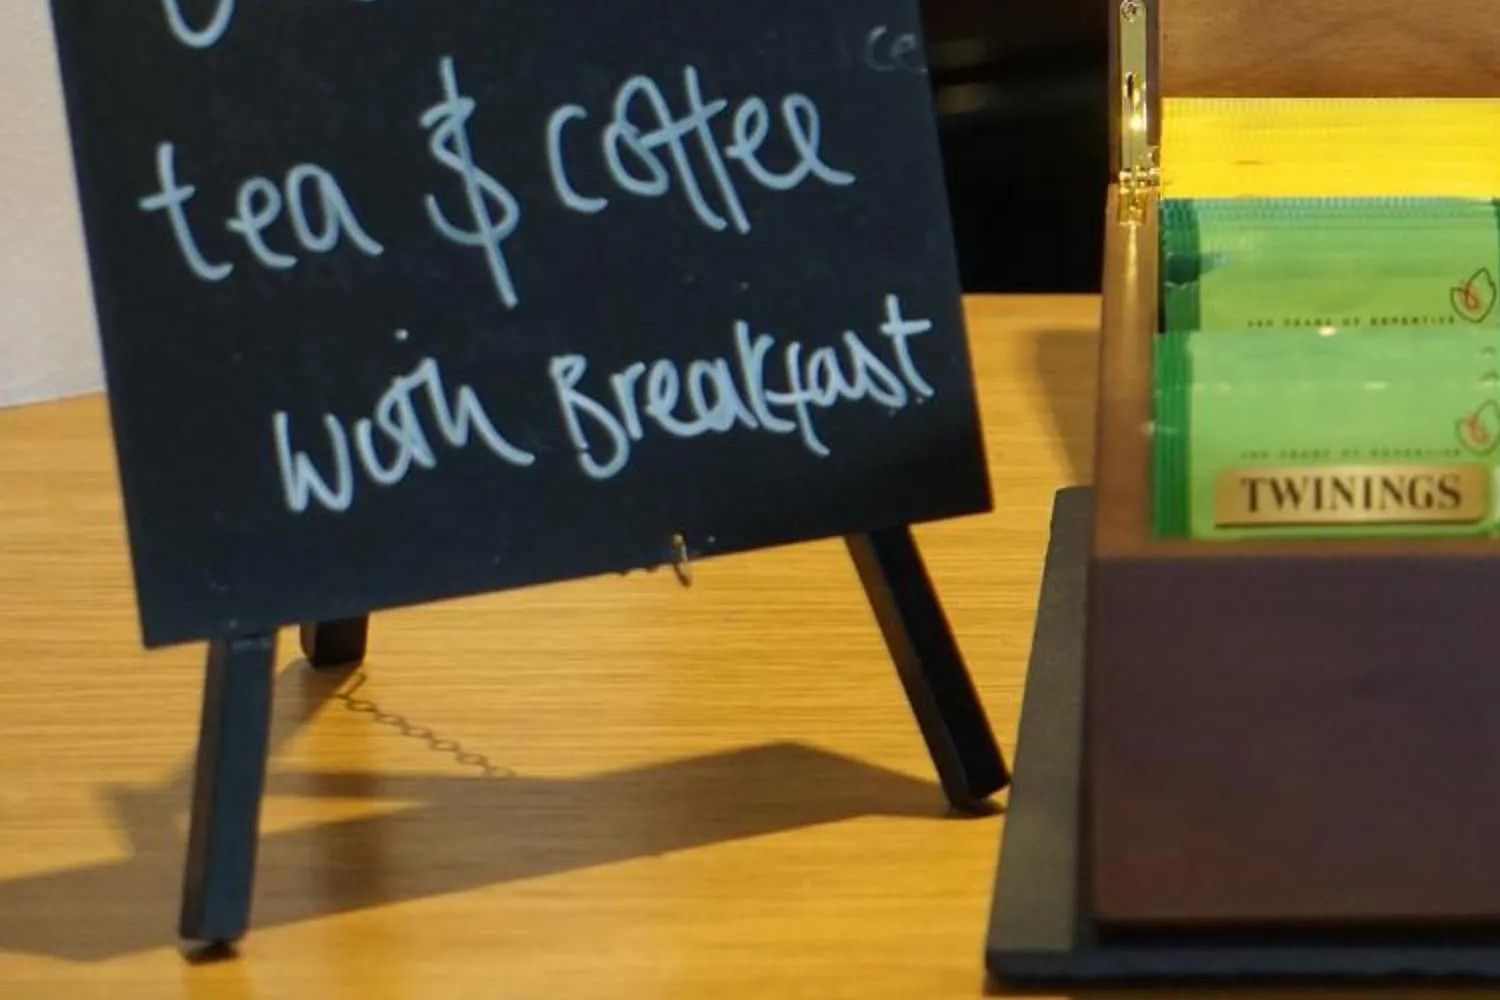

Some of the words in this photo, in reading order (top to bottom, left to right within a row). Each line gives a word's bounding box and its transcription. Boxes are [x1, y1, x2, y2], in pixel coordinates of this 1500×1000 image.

[140, 142, 384, 281] tea
[549, 294, 934, 479] Breakfast
[1240, 474, 1462, 513] TWININGS
